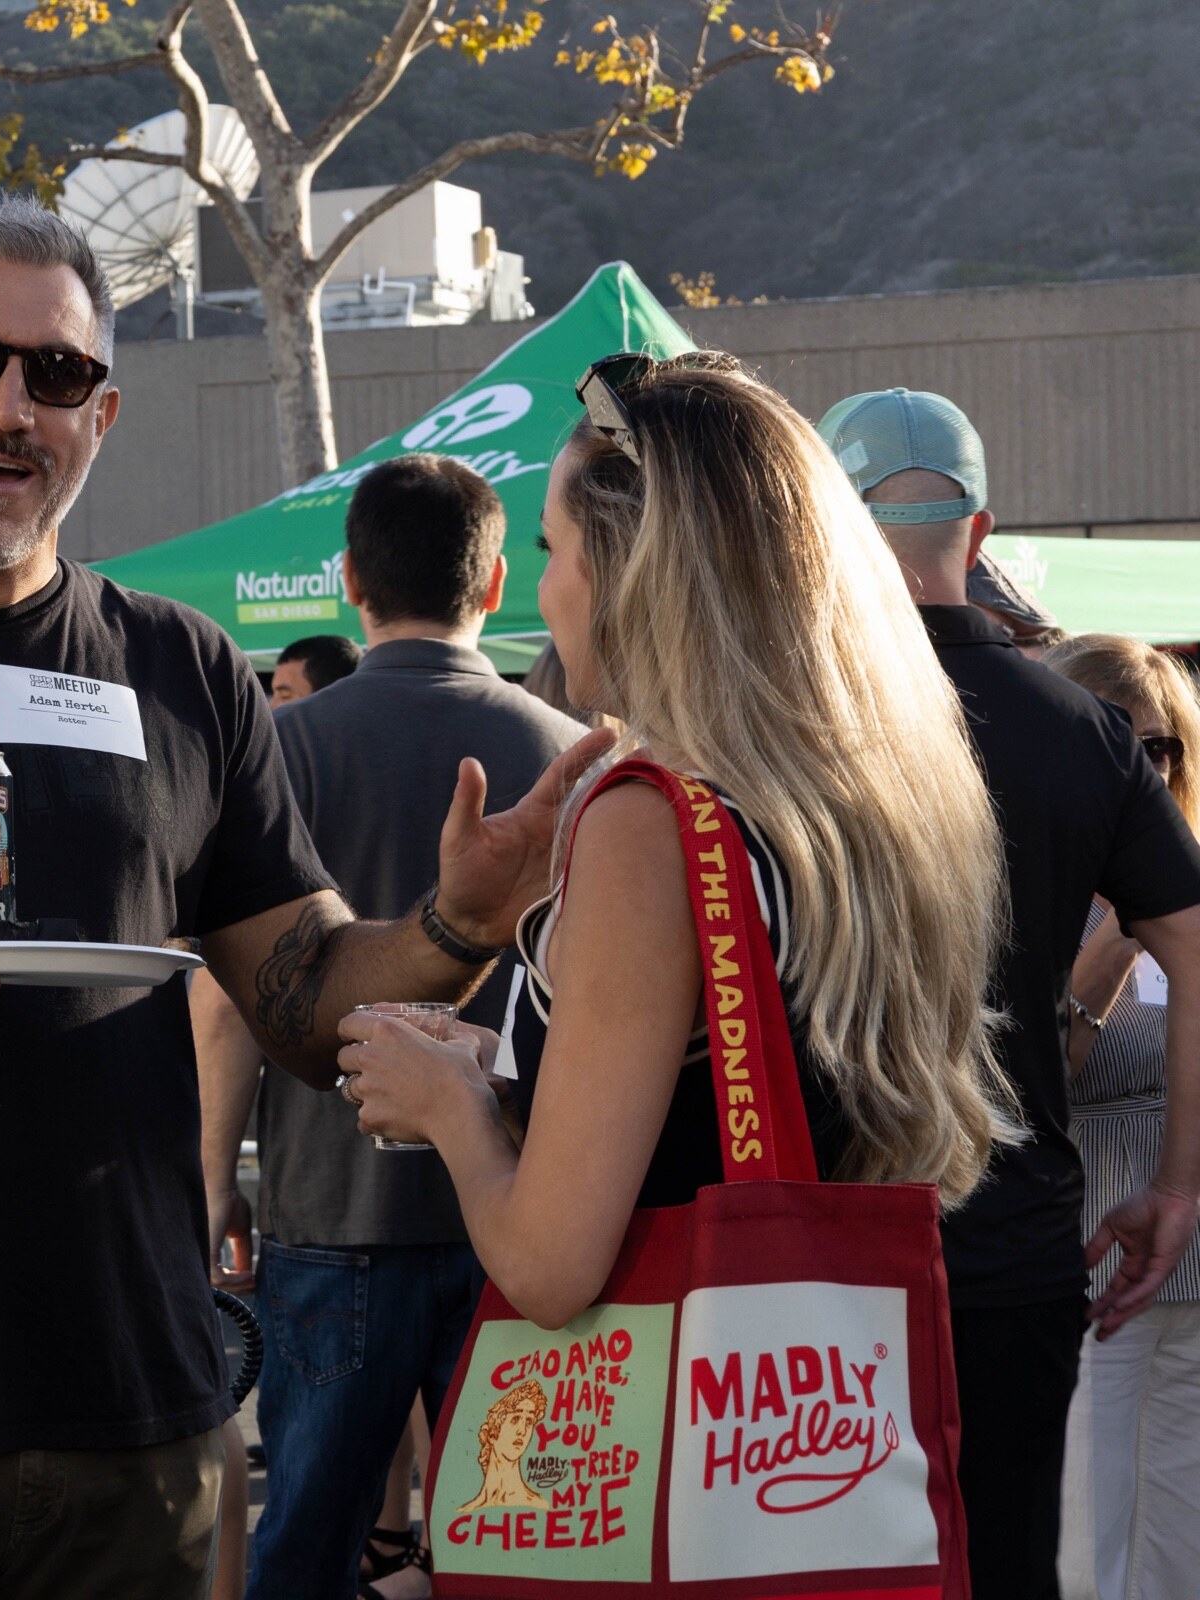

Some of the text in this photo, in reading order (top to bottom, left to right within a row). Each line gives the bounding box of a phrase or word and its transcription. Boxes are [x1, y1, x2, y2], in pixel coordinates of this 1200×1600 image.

[253, 603, 322, 619] SAN DIEGO
[53, 676, 101, 696] MEETUP
[29, 694, 110, 715] Adam Hertel
[57, 715, 87, 726] Rotten
[698, 843, 731, 921] THE
[708, 934, 764, 1163] MADNESS
[490, 1349, 561, 1390] CIAO
[690, 1345, 878, 1427] MADLY
[550, 1378, 616, 1427] HAVE
[534, 1422, 596, 1453] YOU
[526, 1456, 568, 1471] MADLY
[571, 1444, 640, 1482] TRIED
[703, 1399, 878, 1514] Hadley
[526, 1468, 567, 1487] Hadley
[552, 1481, 593, 1510] MY
[447, 1476, 631, 1551] CHEEZE
